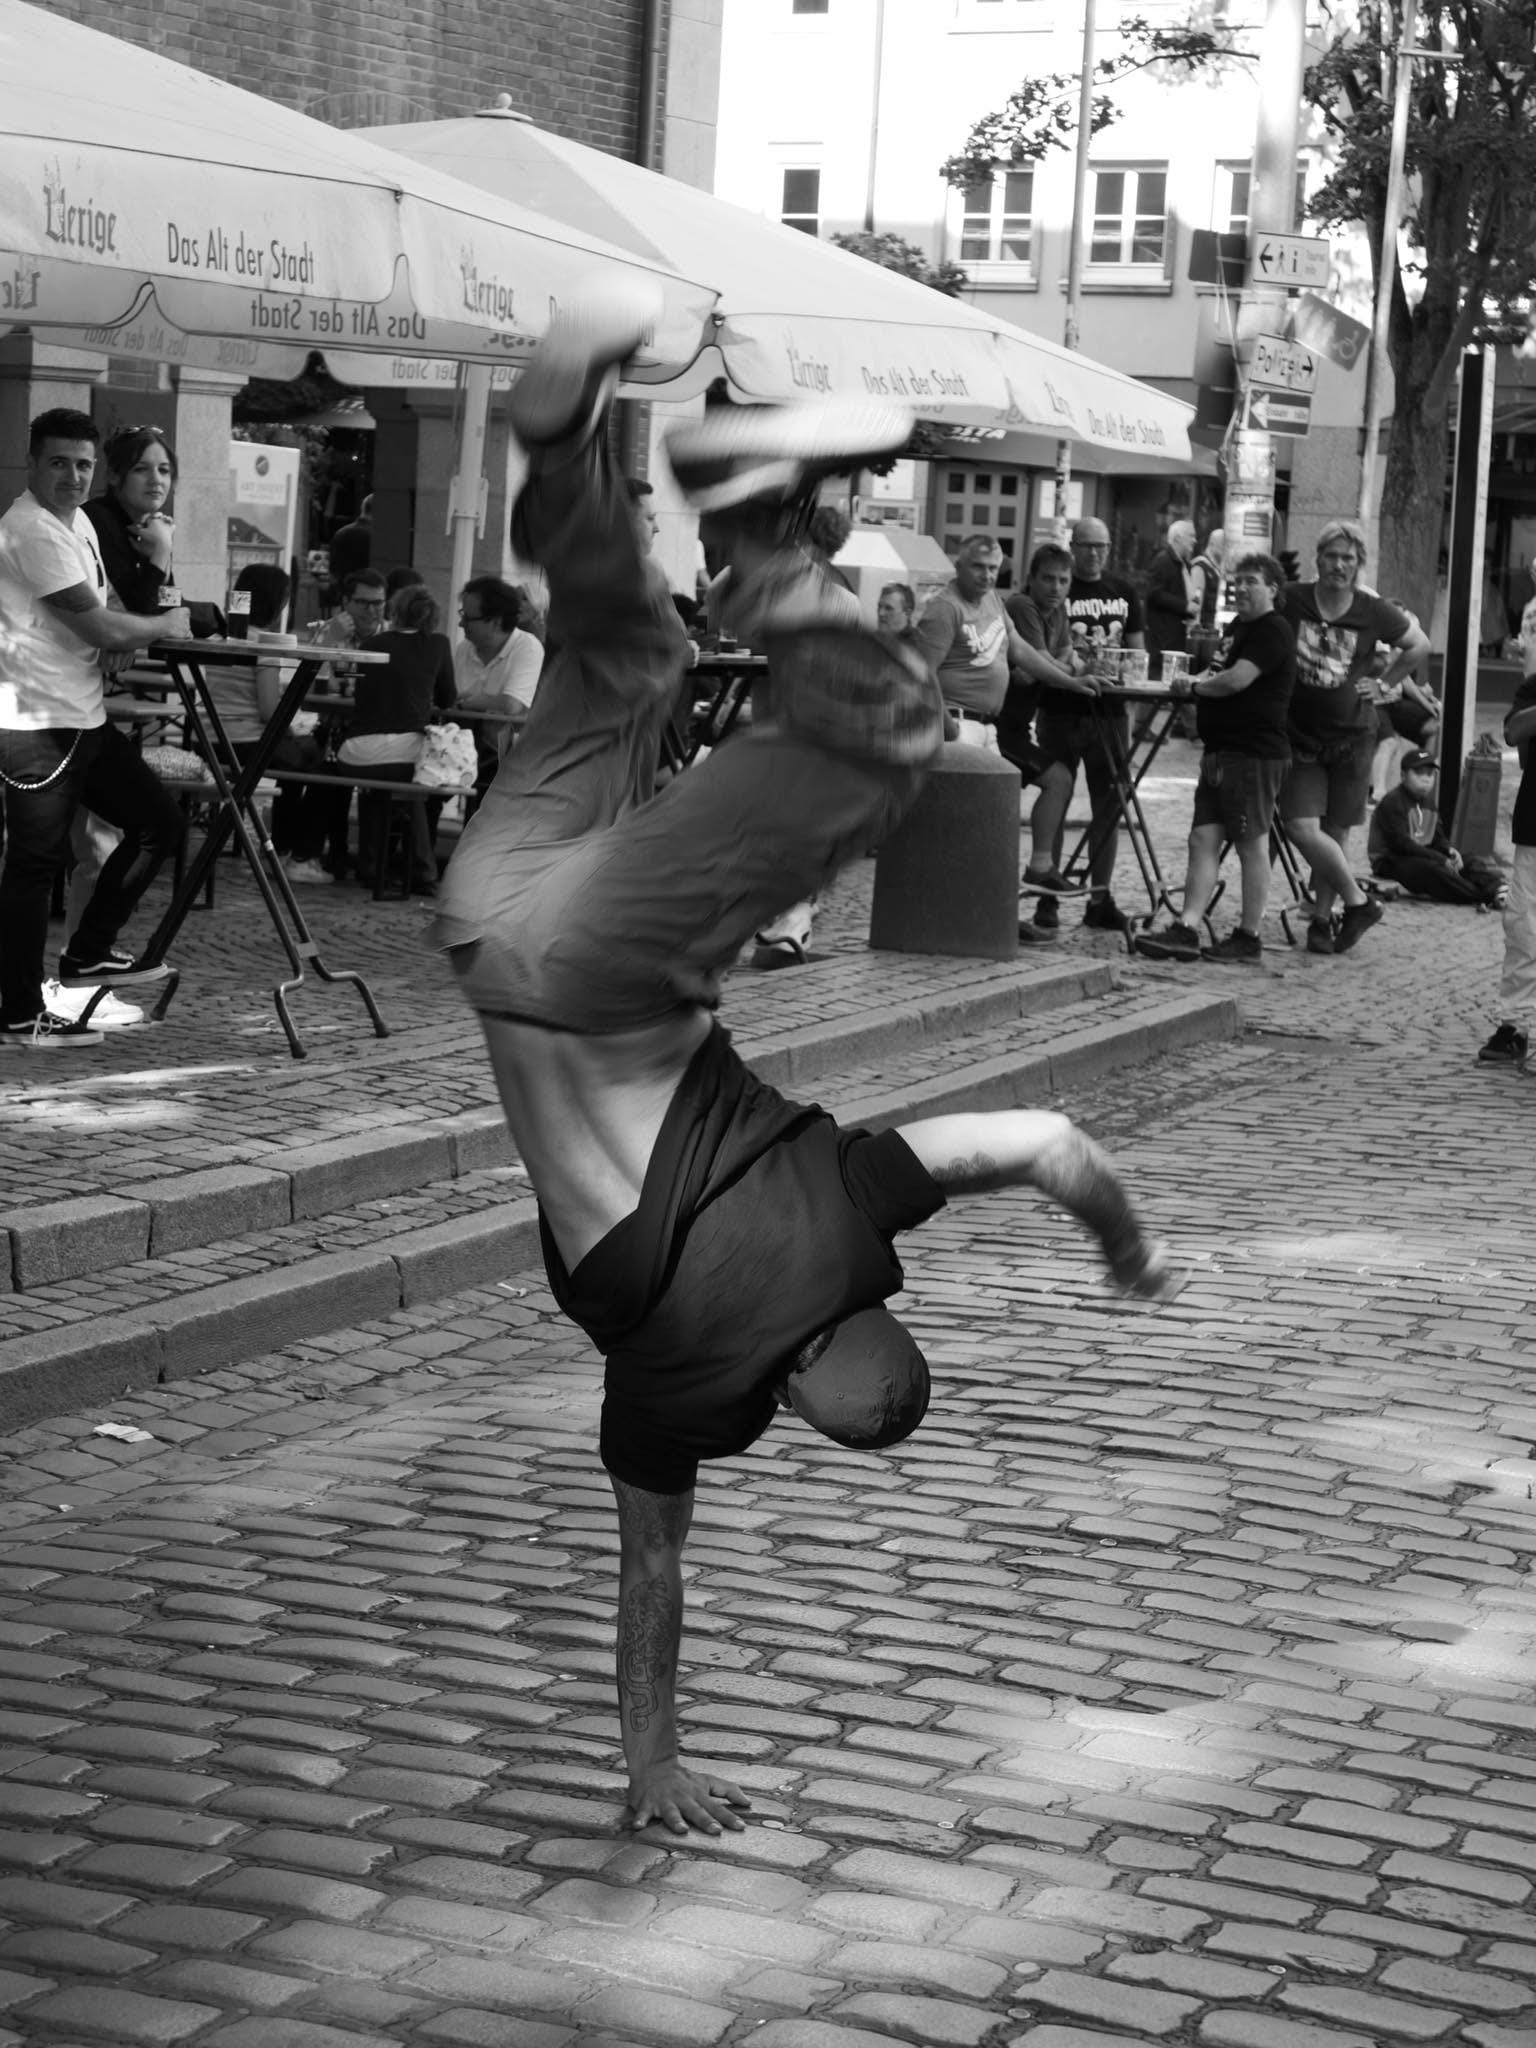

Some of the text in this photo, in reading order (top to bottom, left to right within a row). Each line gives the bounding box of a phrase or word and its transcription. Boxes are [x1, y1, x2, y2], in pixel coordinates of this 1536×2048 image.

[168, 222, 314, 284] Das Alt der Stadt
